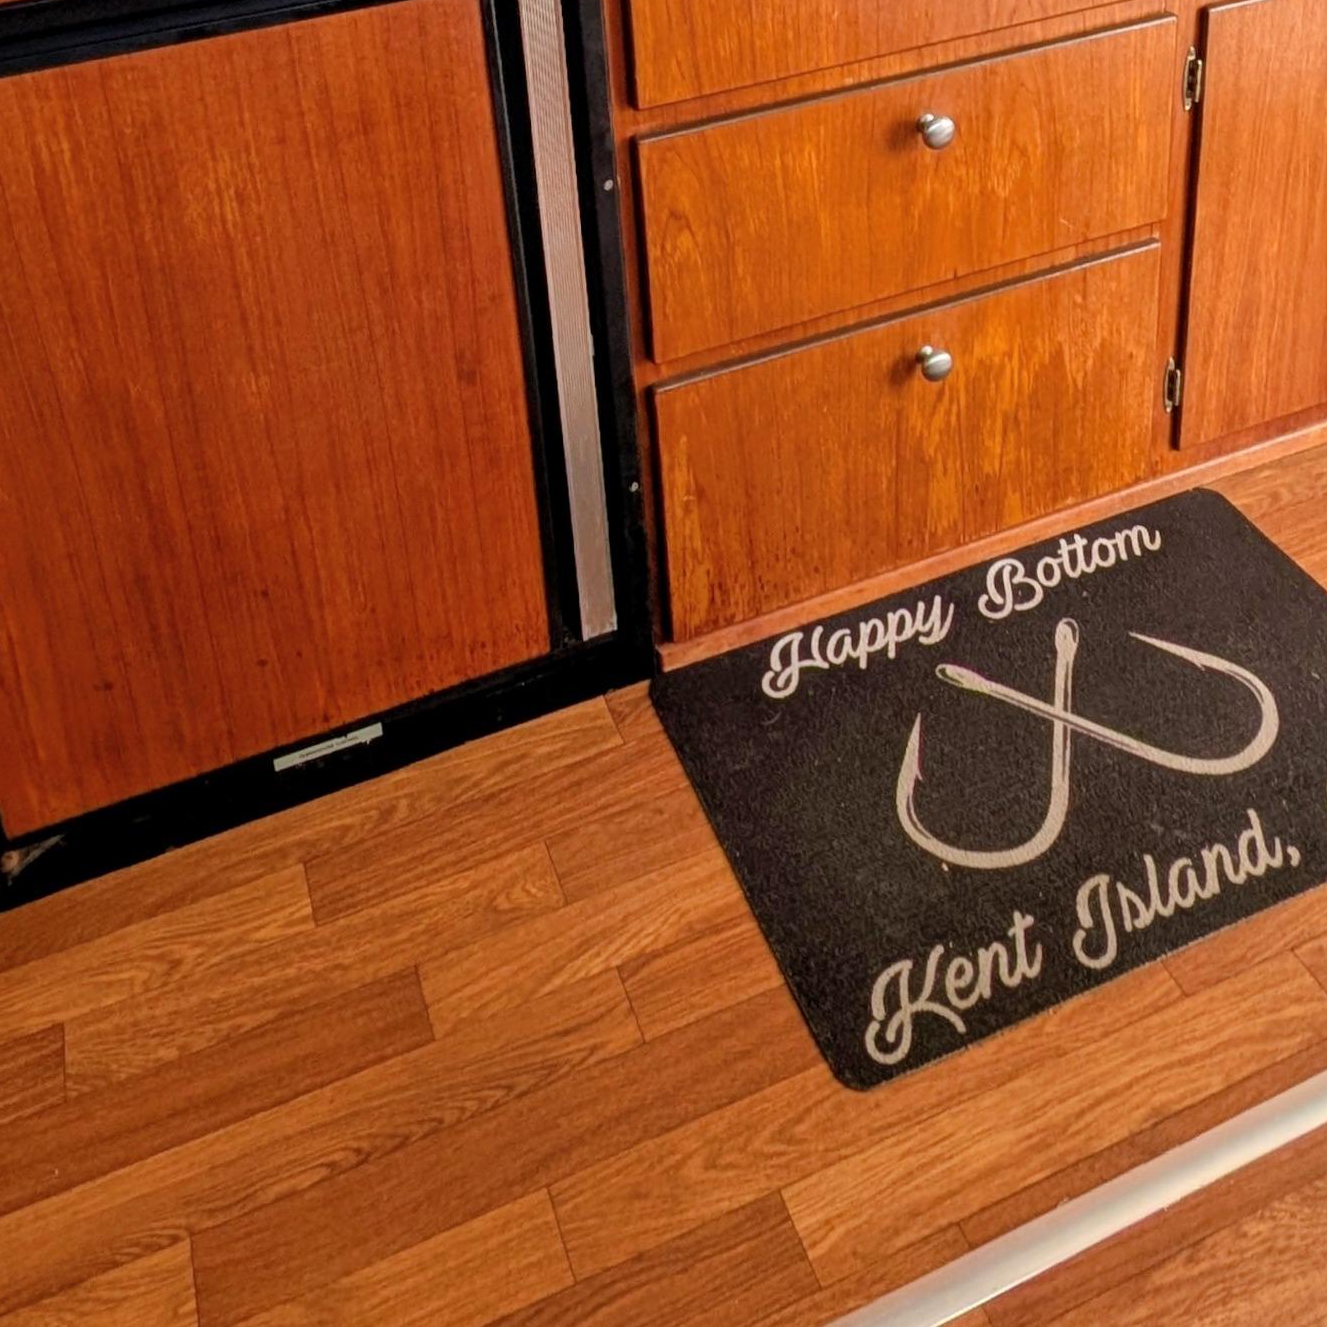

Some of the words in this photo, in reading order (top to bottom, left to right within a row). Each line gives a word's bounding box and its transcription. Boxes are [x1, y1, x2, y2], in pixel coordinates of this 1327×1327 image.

[761, 594, 955, 699] Happy
[977, 524, 1162, 620] Bottom
[864, 909, 1043, 1065] Kent
[1073, 808, 1301, 969] Island,
